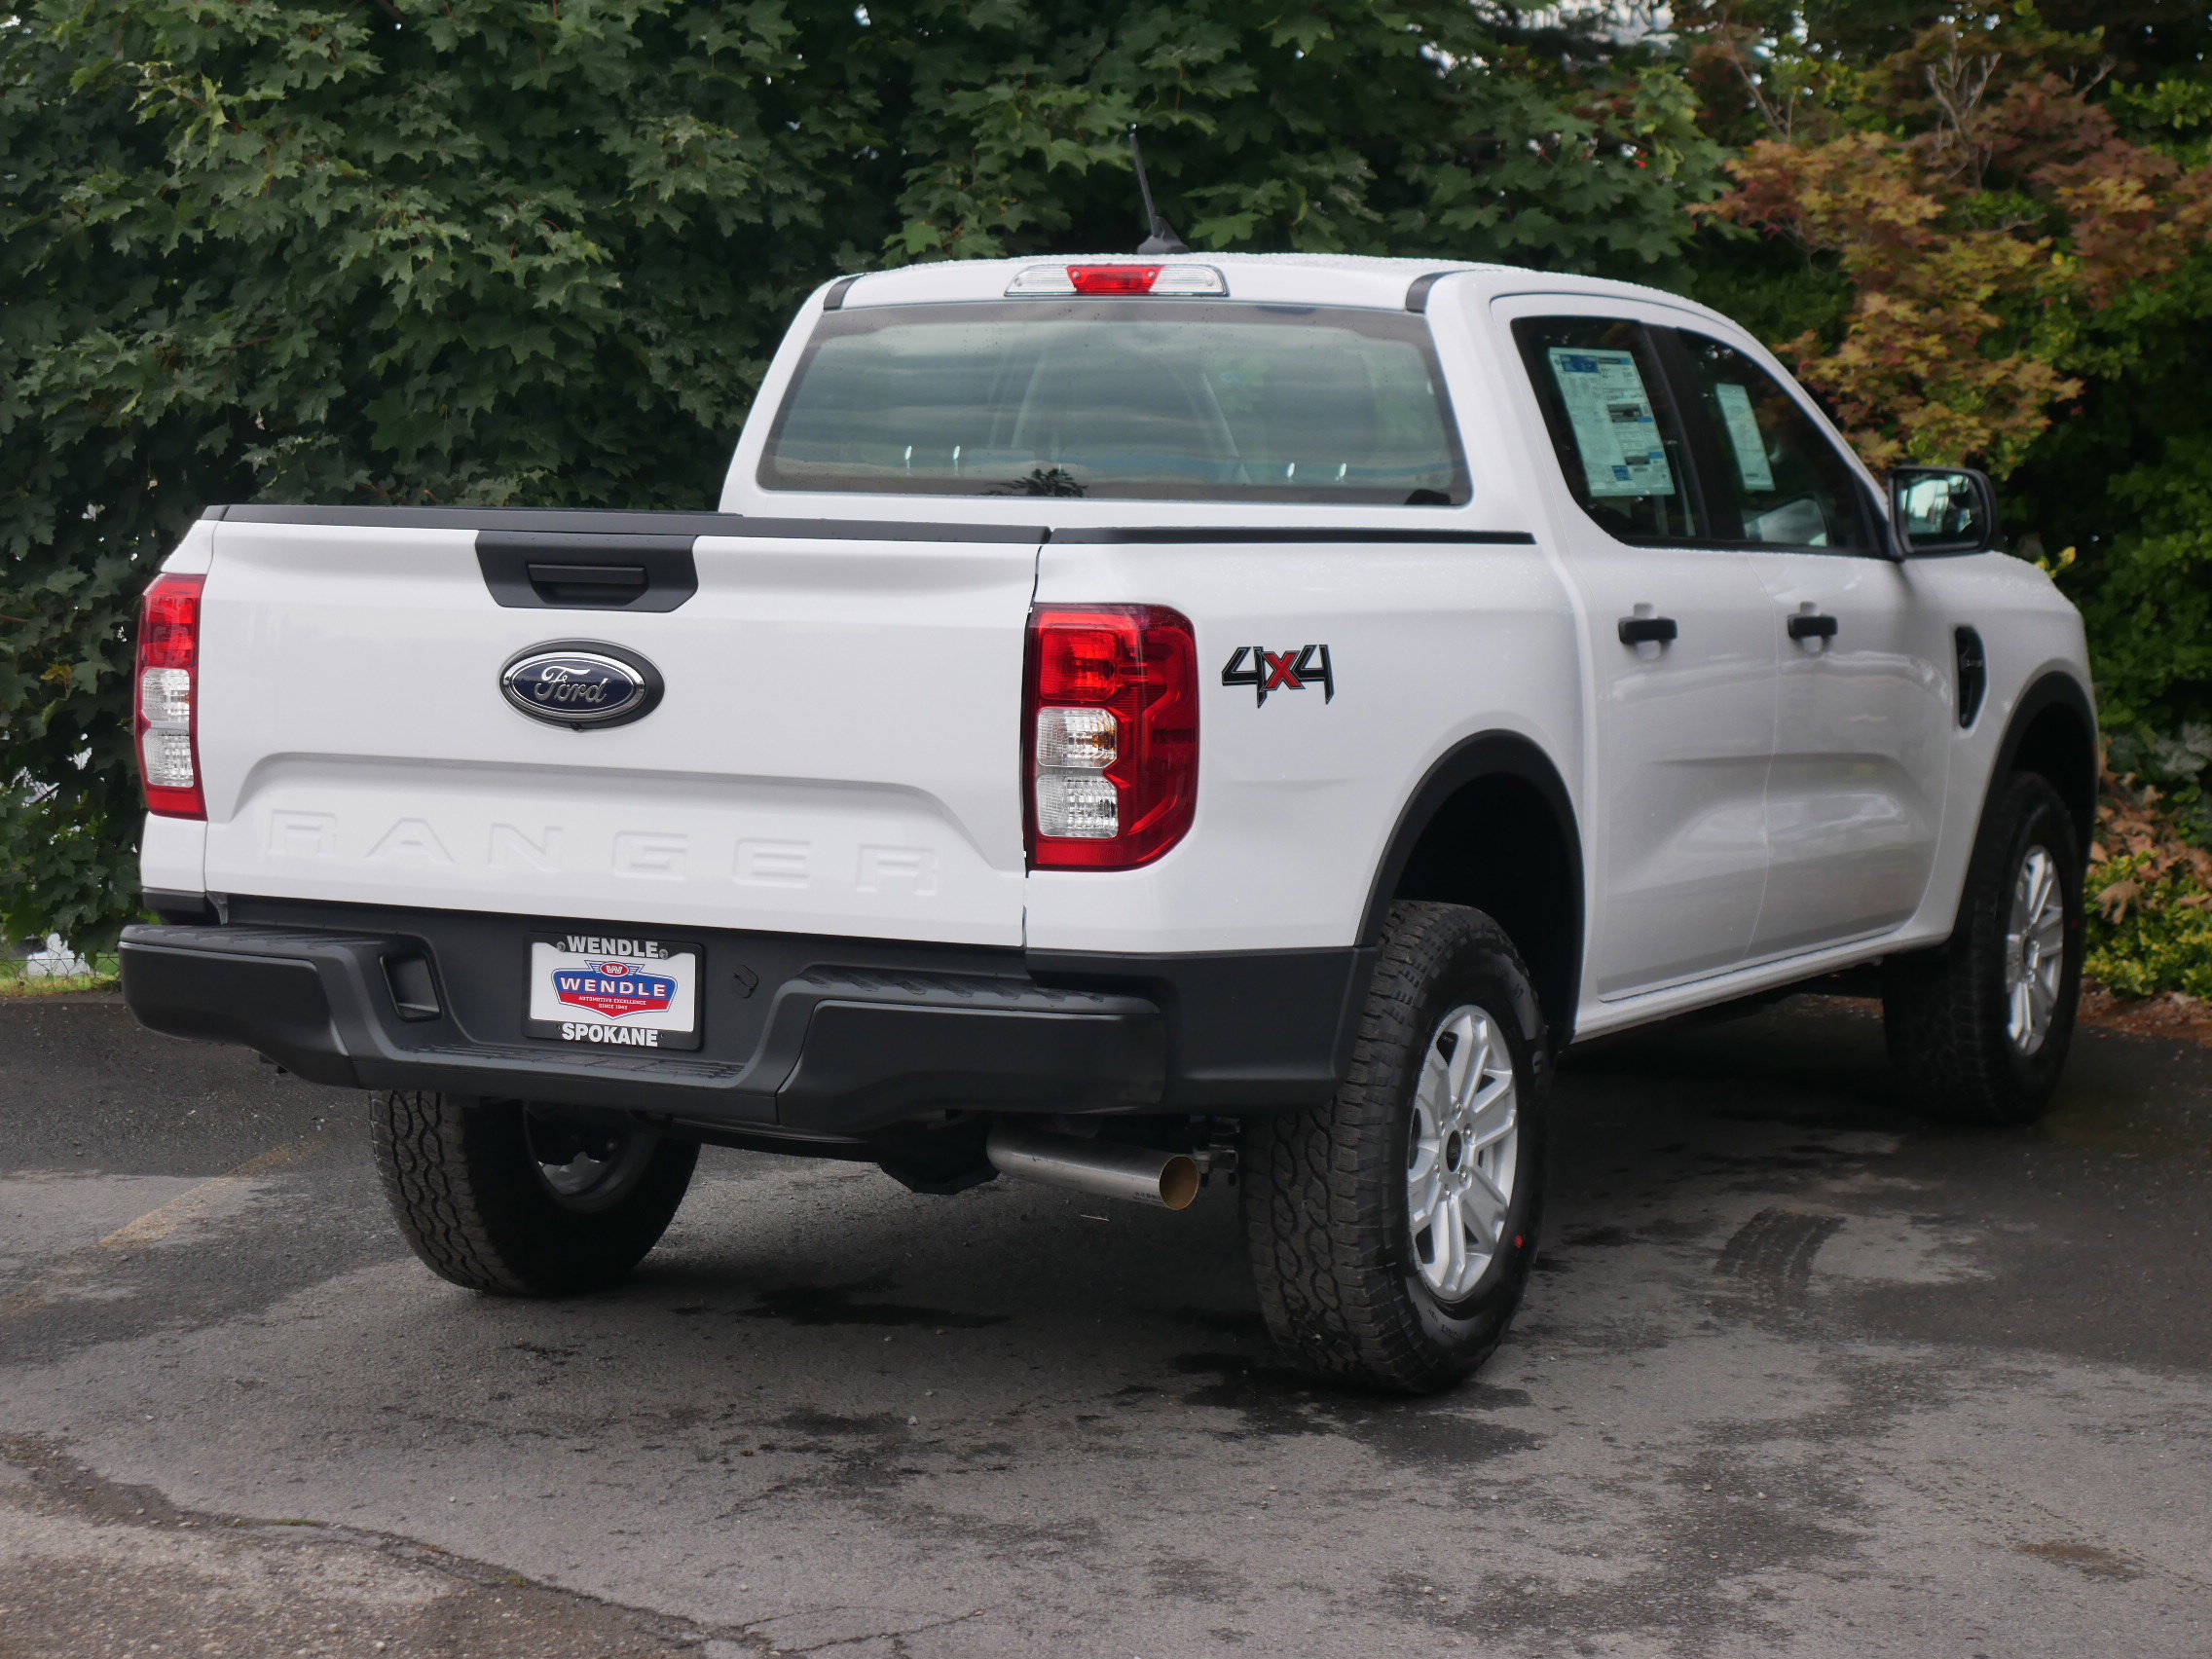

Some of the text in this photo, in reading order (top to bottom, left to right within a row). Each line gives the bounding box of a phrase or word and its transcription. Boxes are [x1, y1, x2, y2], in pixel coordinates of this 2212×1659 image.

[535, 666, 608, 703] Ford
[267, 810, 940, 896] RANGER
[566, 935, 659, 959] WENDLE
[560, 977, 667, 997] WENDLE
[562, 1022, 658, 1048] SPOKANE
